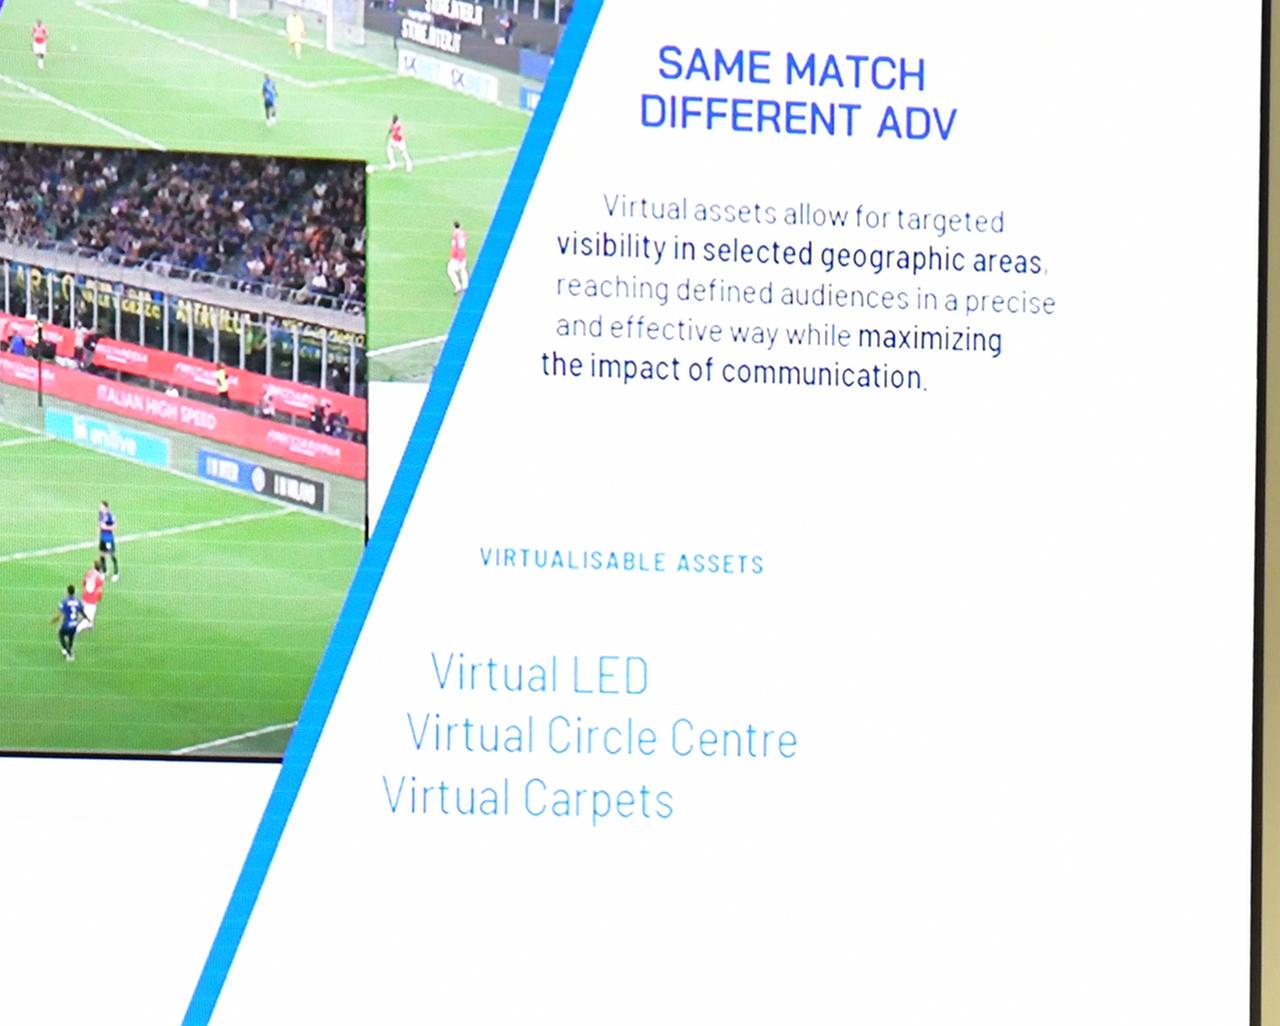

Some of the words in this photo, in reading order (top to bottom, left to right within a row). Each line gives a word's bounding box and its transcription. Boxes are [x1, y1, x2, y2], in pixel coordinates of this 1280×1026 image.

[658, 44, 771, 85] SAME
[786, 51, 925, 92] MATCH
[640, 93, 862, 137] DIFFERENT
[876, 105, 958, 141] ADV
[603, 193, 687, 221] Virtual
[693, 203, 777, 225] assets
[783, 202, 849, 227] allow
[855, 203, 888, 229] for
[897, 208, 1004, 238] targeted
[557, 230, 667, 266] visibility
[674, 235, 696, 261] in
[703, 237, 813, 266] selected
[820, 245, 965, 276] geographic
[972, 252, 1049, 276] areas,
[556, 275, 669, 307] reaching
[676, 277, 773, 305] defined
[780, 283, 910, 310] audiences
[917, 286, 938, 311] in
[944, 293, 958, 312] a
[965, 290, 1056, 317] precise
[556, 314, 603, 338] and
[610, 314, 723, 343] effective
[729, 326, 779, 351] way
[785, 322, 852, 348] while
[858, 324, 1002, 359] maximizing
[541, 350, 583, 377] the
[591, 352, 680, 385] impact
[688, 356, 714, 382] of
[722, 361, 927, 392] communication.
[146, 397, 178, 419] HIGH
[479, 547, 665, 573] VIRTUALISABLE
[676, 553, 764, 575] ASSETS
[431, 651, 557, 693] Virtual
[573, 655, 649, 696] LED
[406, 712, 533, 753] Virtual
[548, 714, 657, 756] Circle
[671, 717, 798, 759] Centre
[382, 775, 509, 816] Virtual
[524, 777, 674, 828] Carpets
